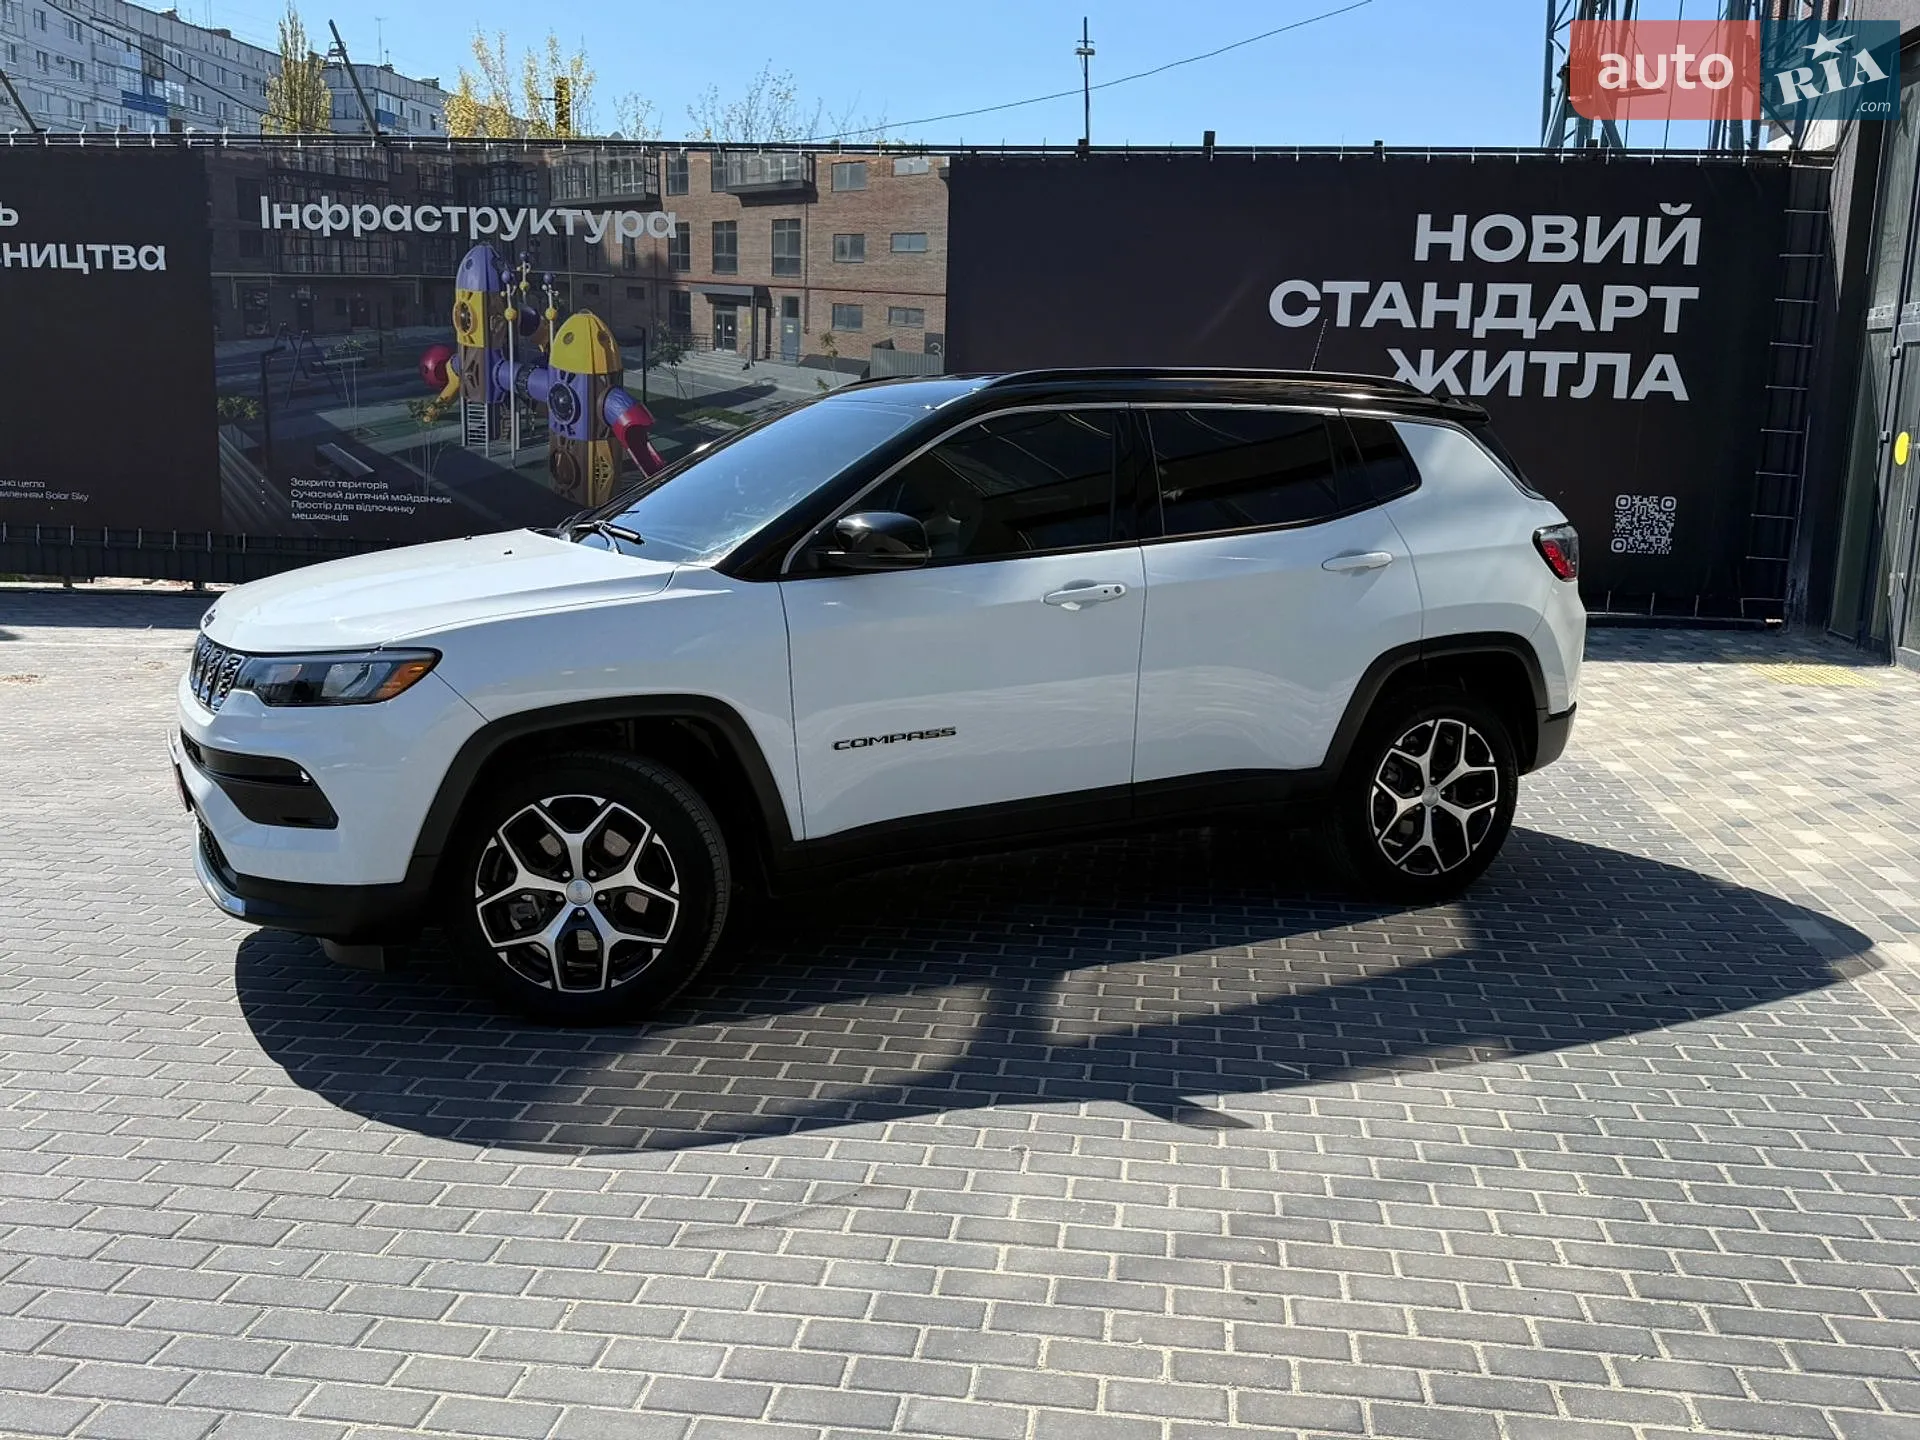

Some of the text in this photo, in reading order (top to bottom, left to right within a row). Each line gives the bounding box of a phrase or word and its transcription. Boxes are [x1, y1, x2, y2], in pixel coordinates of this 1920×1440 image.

[259, 195, 678, 244] Інфраструктура
[1414, 202, 1702, 266] НОВИЙ
[0, 242, 167, 275] ництва
[1267, 279, 1700, 339] СТАНДАРТ
[1386, 348, 1690, 401] ЖИТЛА
[45, 490, 69, 500] Solar
[71, 491, 89, 503] Sky
[290, 477, 389, 491] Закрита територія
[290, 488, 343, 500] Сучасний
[344, 491, 390, 502] дитячий
[291, 500, 333, 511] Простір
[333, 501, 355, 511] для
[291, 512, 350, 523] мешканців
[832, 726, 957, 751] COMPASS
